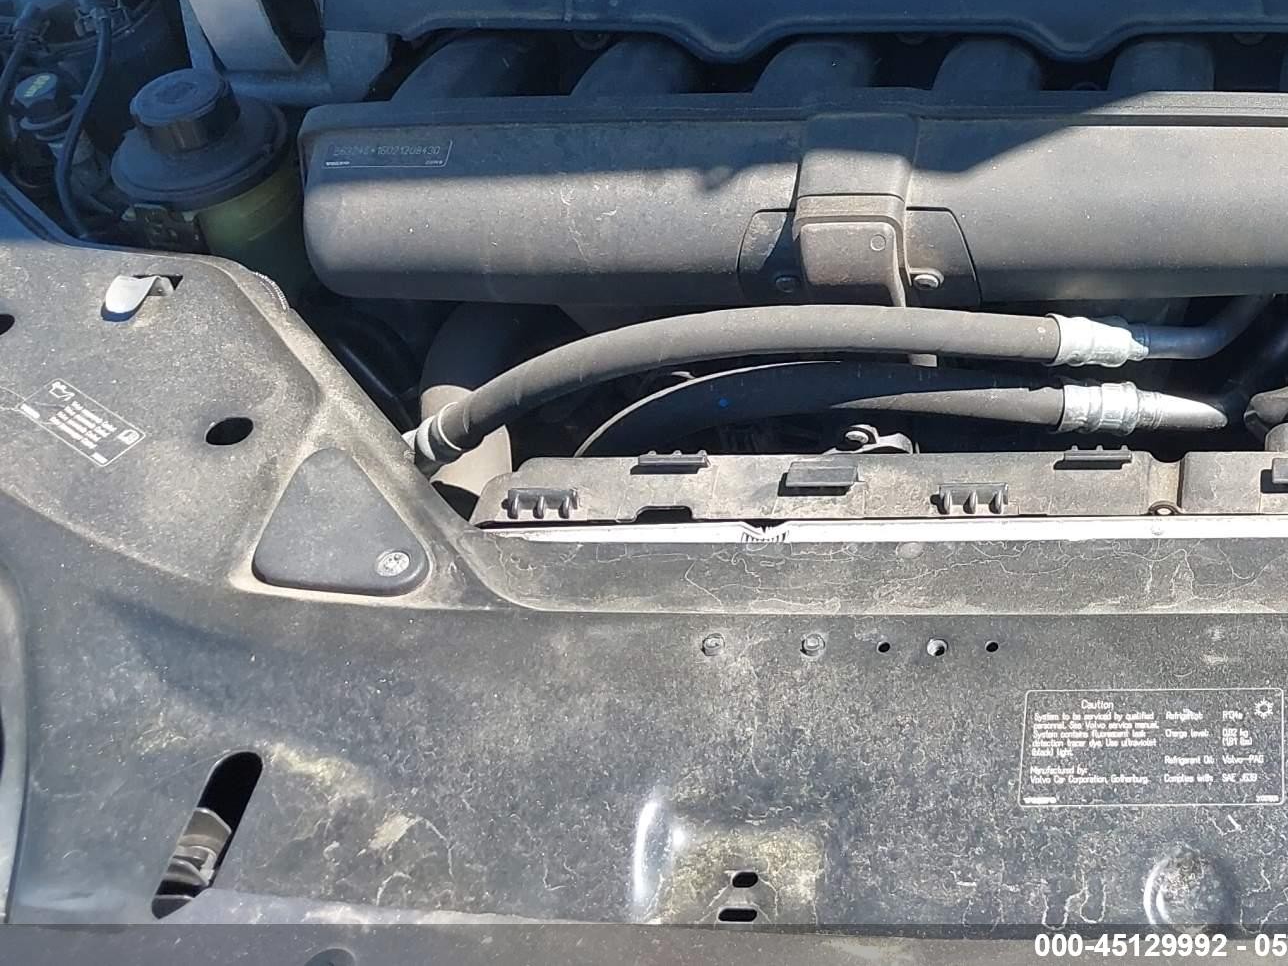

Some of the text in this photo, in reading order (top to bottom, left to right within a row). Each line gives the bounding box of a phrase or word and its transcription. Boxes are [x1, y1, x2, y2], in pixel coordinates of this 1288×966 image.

[1081, 700, 1114, 709] Caution
[1114, 712, 1122, 721] by
[1085, 721, 1106, 729] Volvo
[1030, 776, 1051, 784] Volvo
